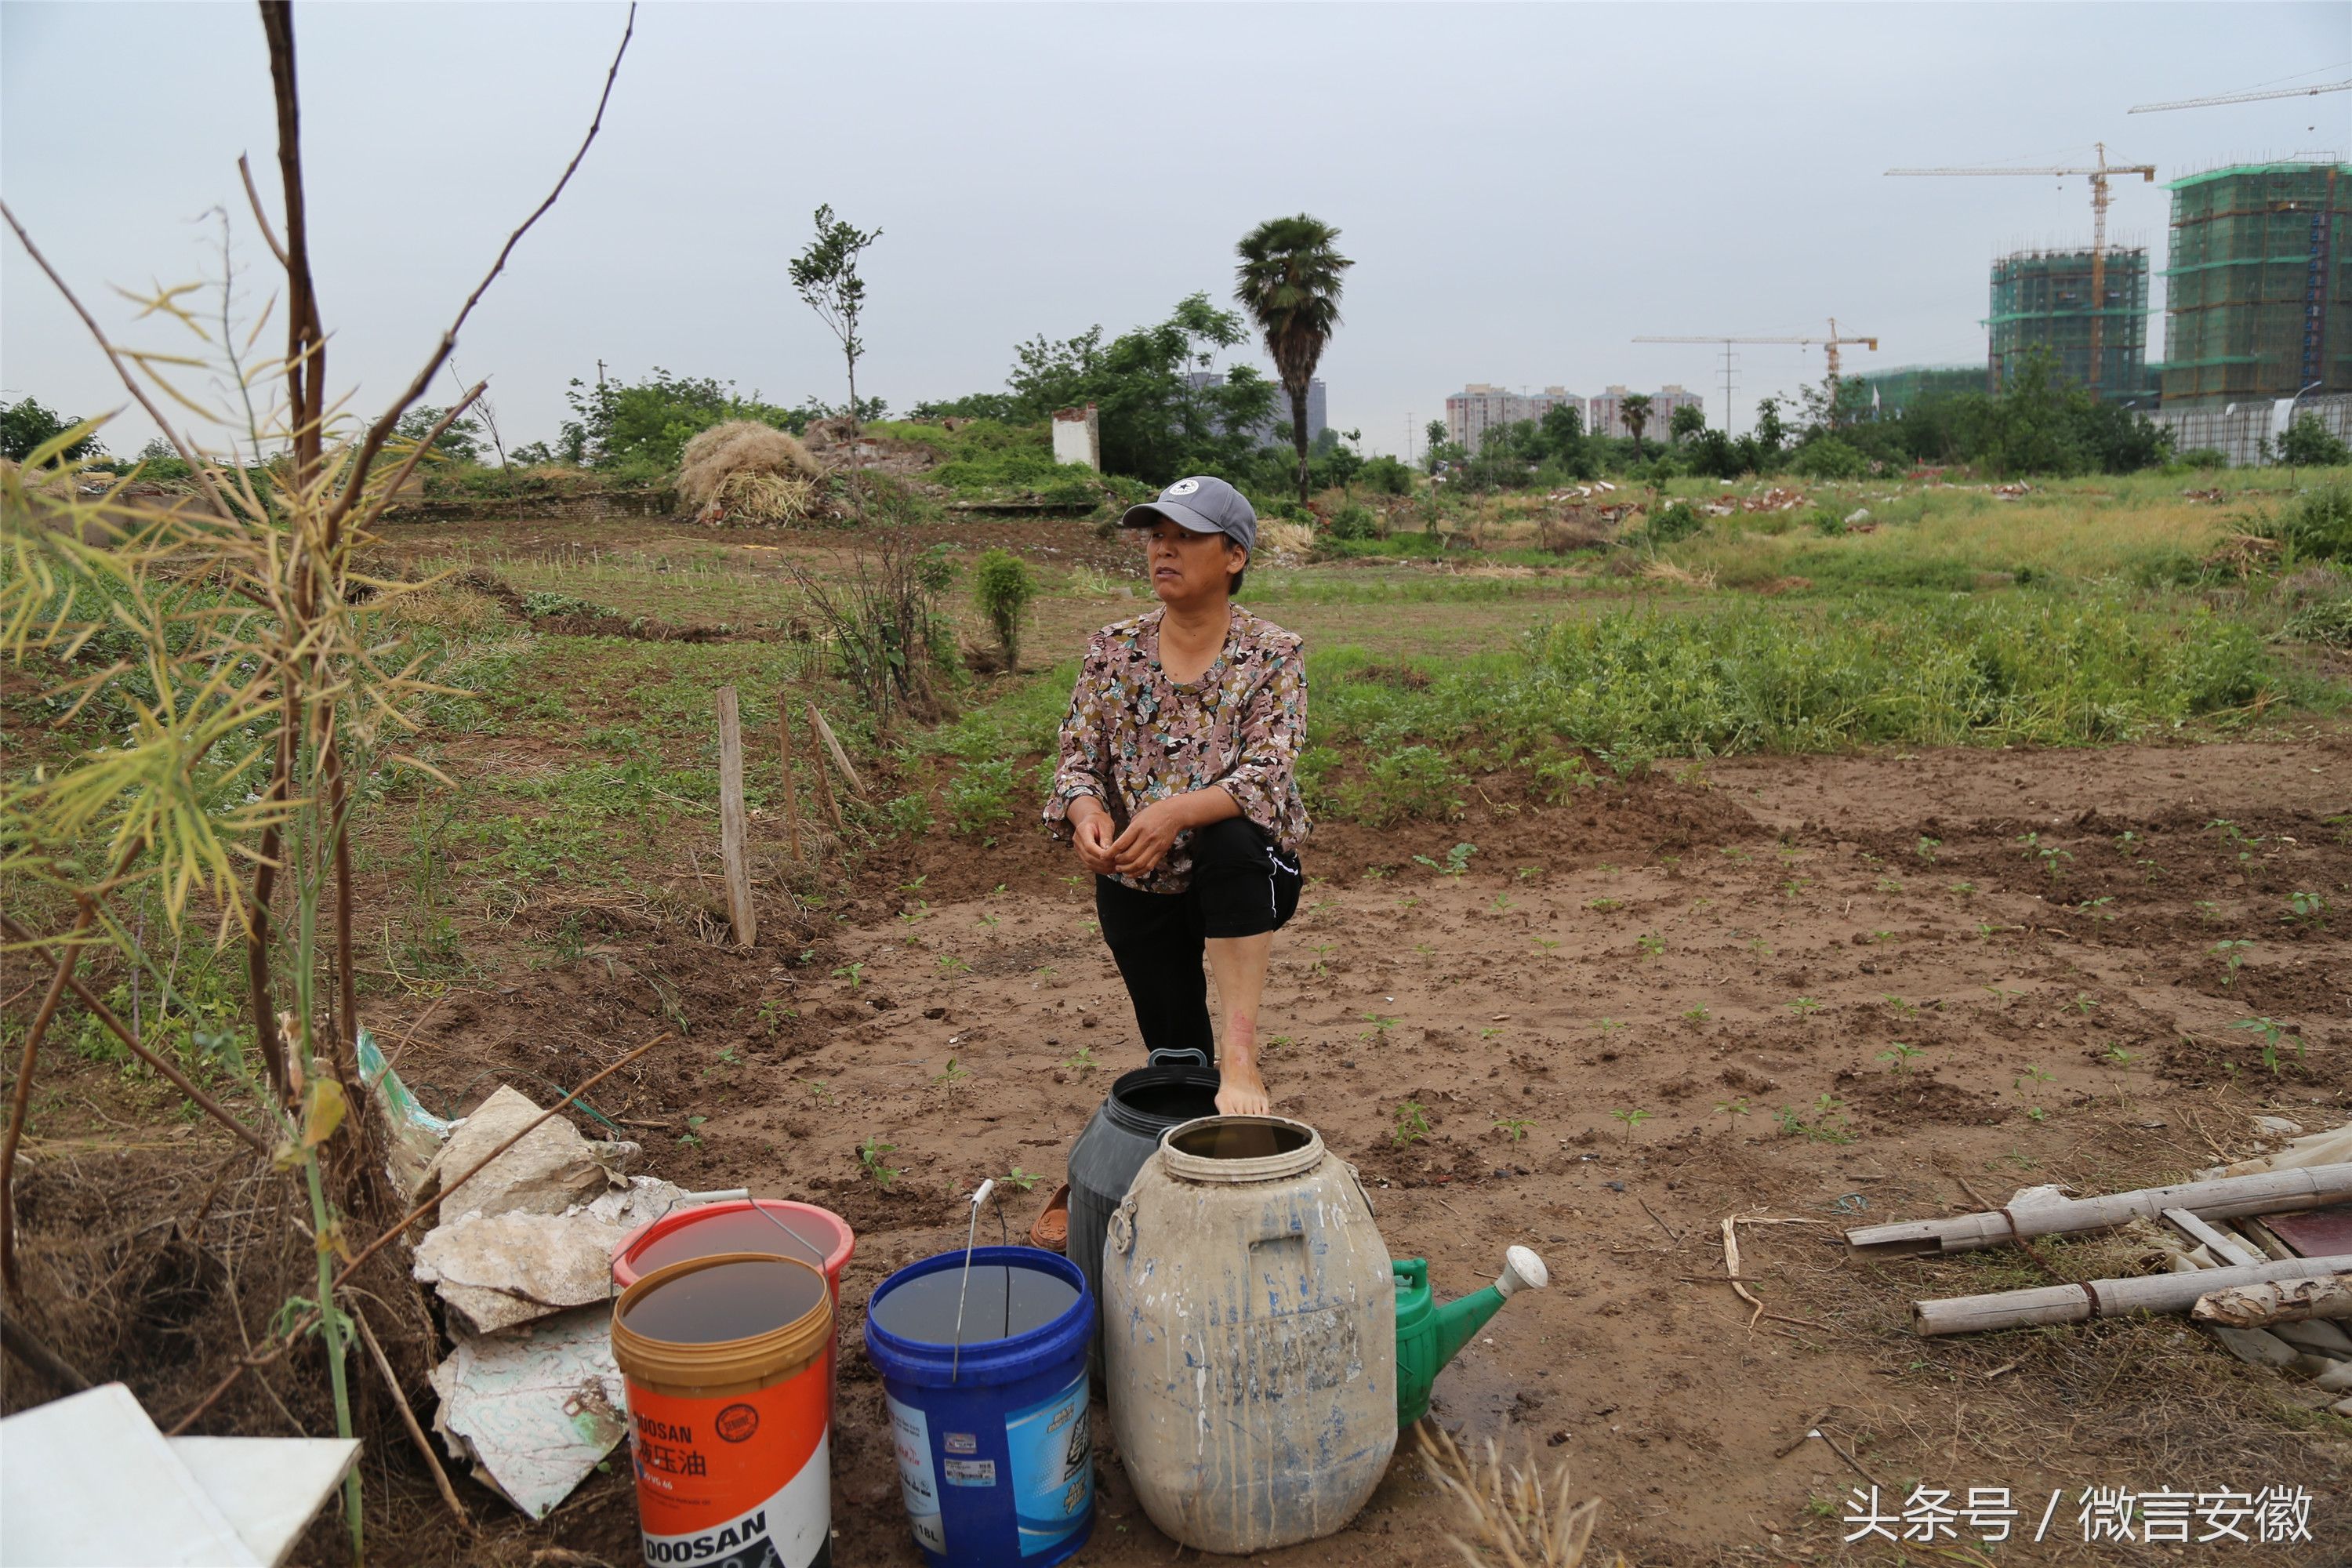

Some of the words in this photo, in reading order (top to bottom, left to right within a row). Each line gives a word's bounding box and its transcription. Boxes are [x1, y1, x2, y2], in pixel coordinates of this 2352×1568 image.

[639, 1438, 706, 1477] 液压油
[646, 1510, 766, 1563] DOOSAN
